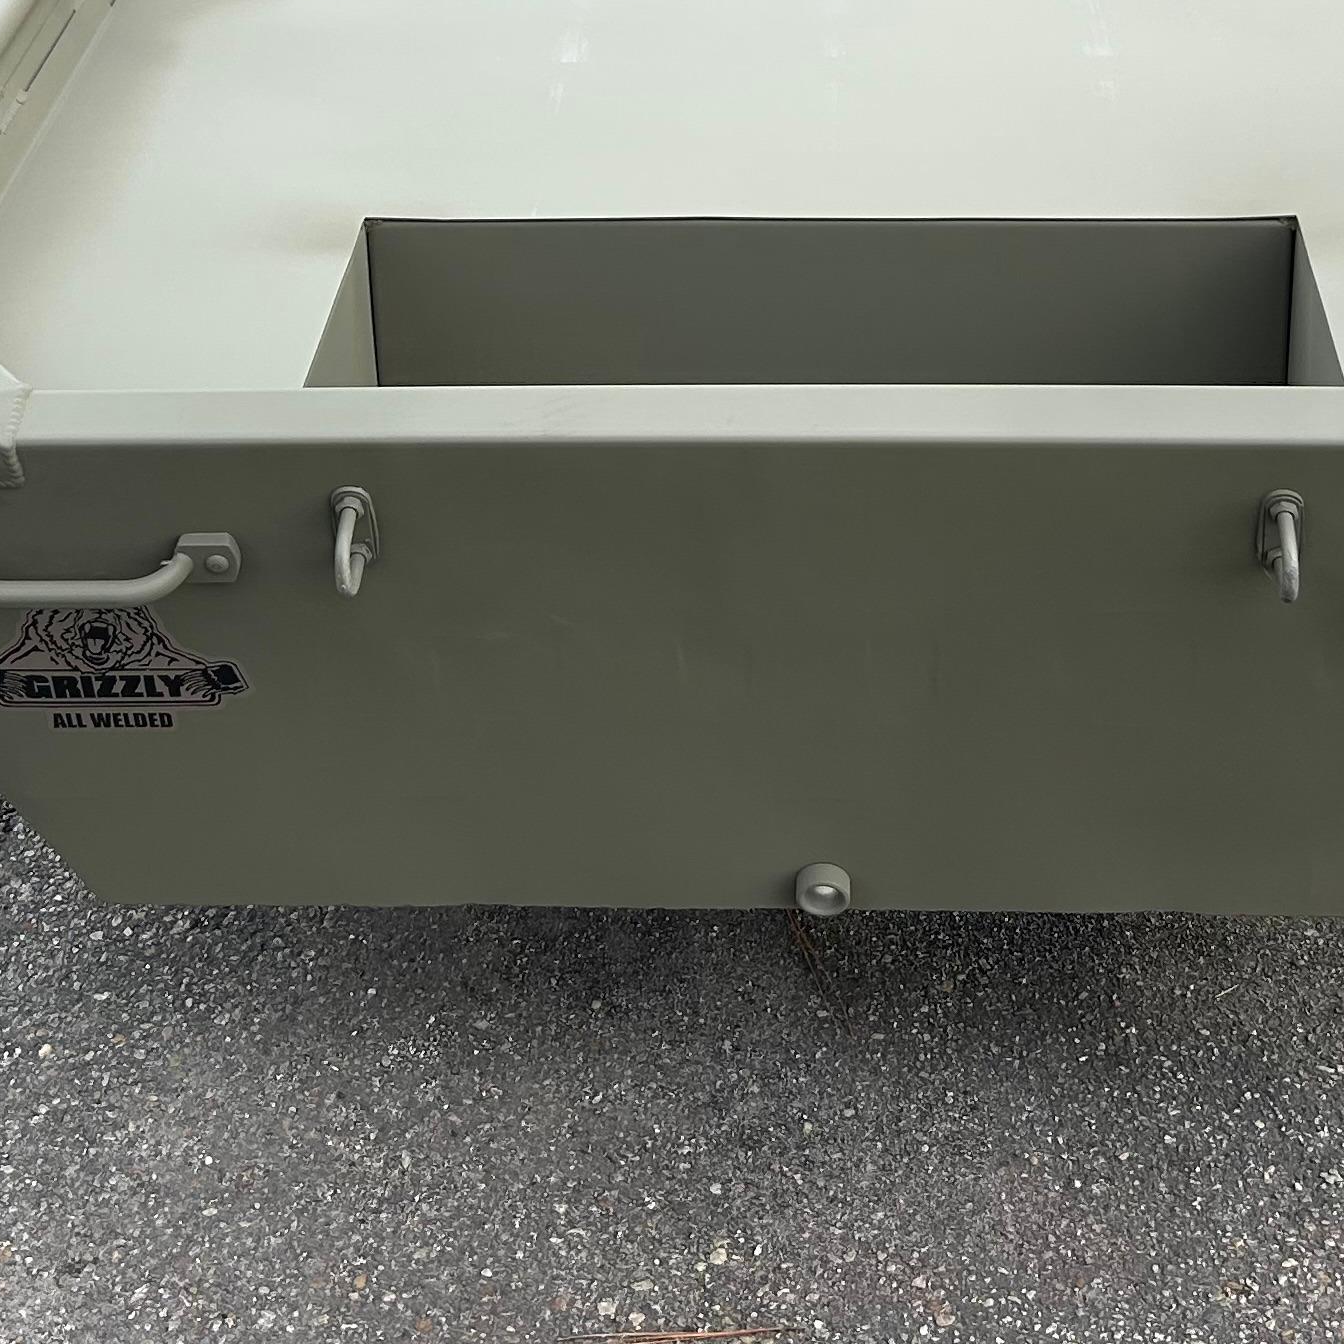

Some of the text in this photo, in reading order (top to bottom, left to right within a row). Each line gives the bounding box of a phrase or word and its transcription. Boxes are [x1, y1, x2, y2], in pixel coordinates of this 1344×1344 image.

[26, 675, 184, 698] GRIZZLY
[53, 713, 174, 728] ALL WELDED
